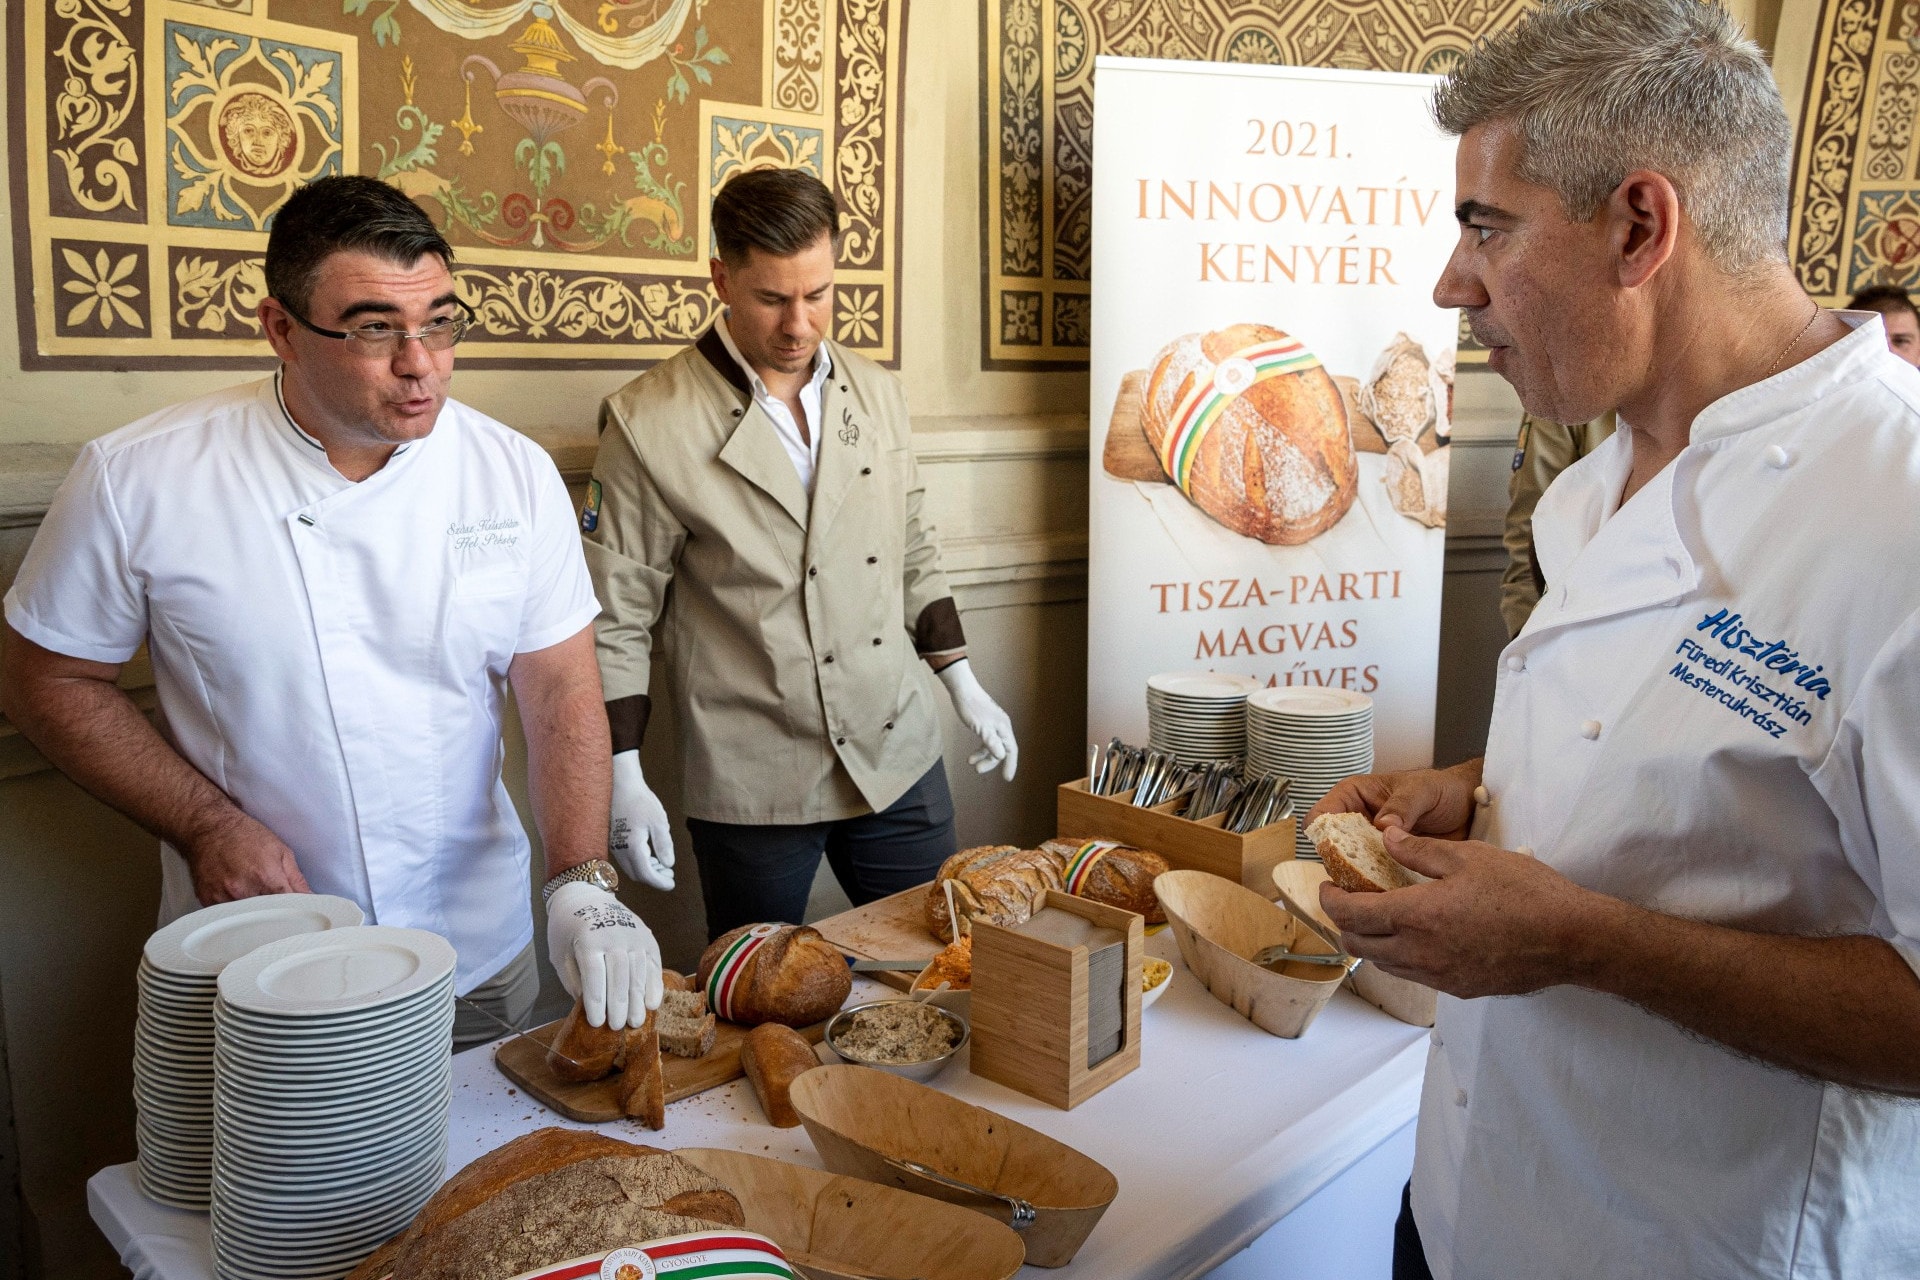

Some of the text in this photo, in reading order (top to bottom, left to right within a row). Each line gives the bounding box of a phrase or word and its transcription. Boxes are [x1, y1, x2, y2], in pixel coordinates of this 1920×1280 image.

[1245, 119, 1353, 159] 2021.
[1135, 175, 1442, 227] INNOVATÍV
[1198, 234, 1400, 286] KENYÉR
[1150, 570, 1403, 614] TISZA-PARTI
[1194, 619, 1358, 660] MAGVAS
[1696, 607, 1832, 700] Hisztéria
[1669, 662, 1788, 739] Mestercukrász
[1675, 638, 1812, 727] Füredi Krisztián
